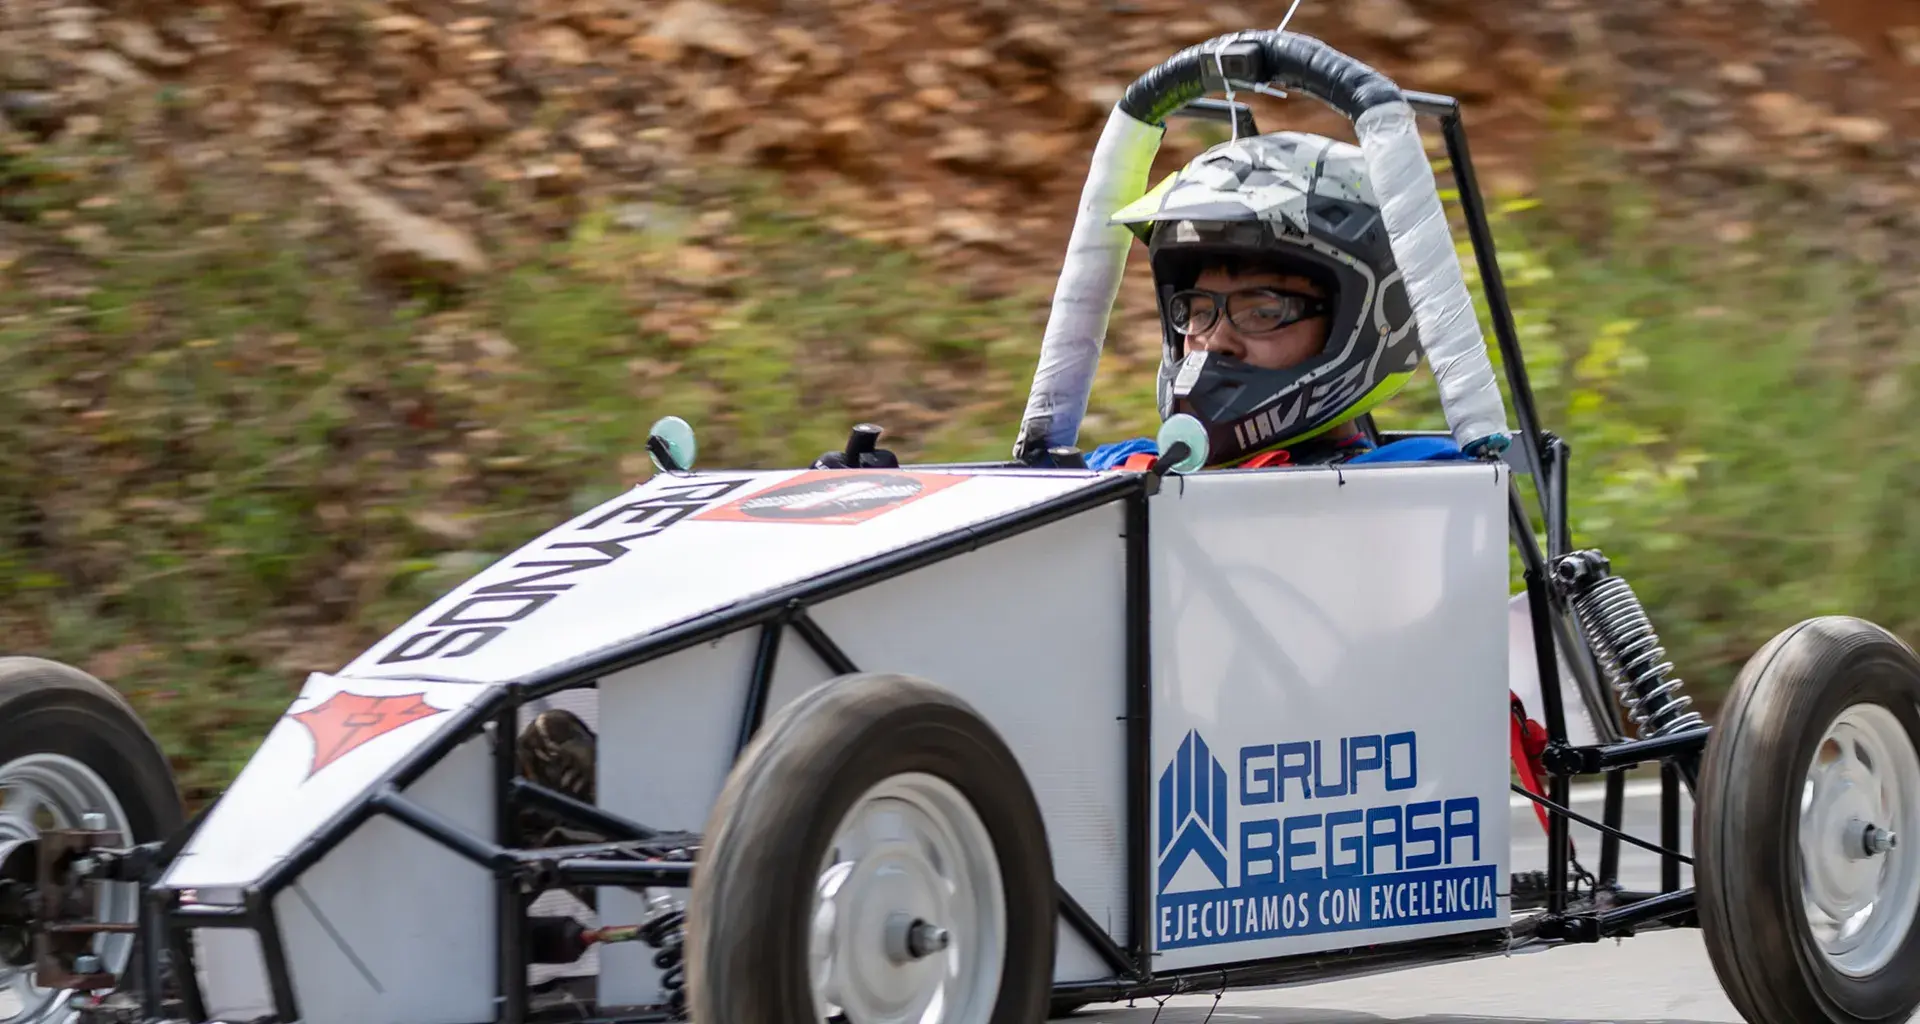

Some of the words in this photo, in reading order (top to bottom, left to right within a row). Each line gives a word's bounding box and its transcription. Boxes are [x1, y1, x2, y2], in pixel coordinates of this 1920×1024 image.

[376, 478, 756, 665] REYNOS
[1240, 731, 1417, 806] GRUPO
[1240, 797, 1480, 886] BEGASA
[1161, 892, 1310, 943] EJECUTAMOS
[1319, 888, 1361, 925] CON
[1371, 875, 1493, 920] EXCELENCIA
